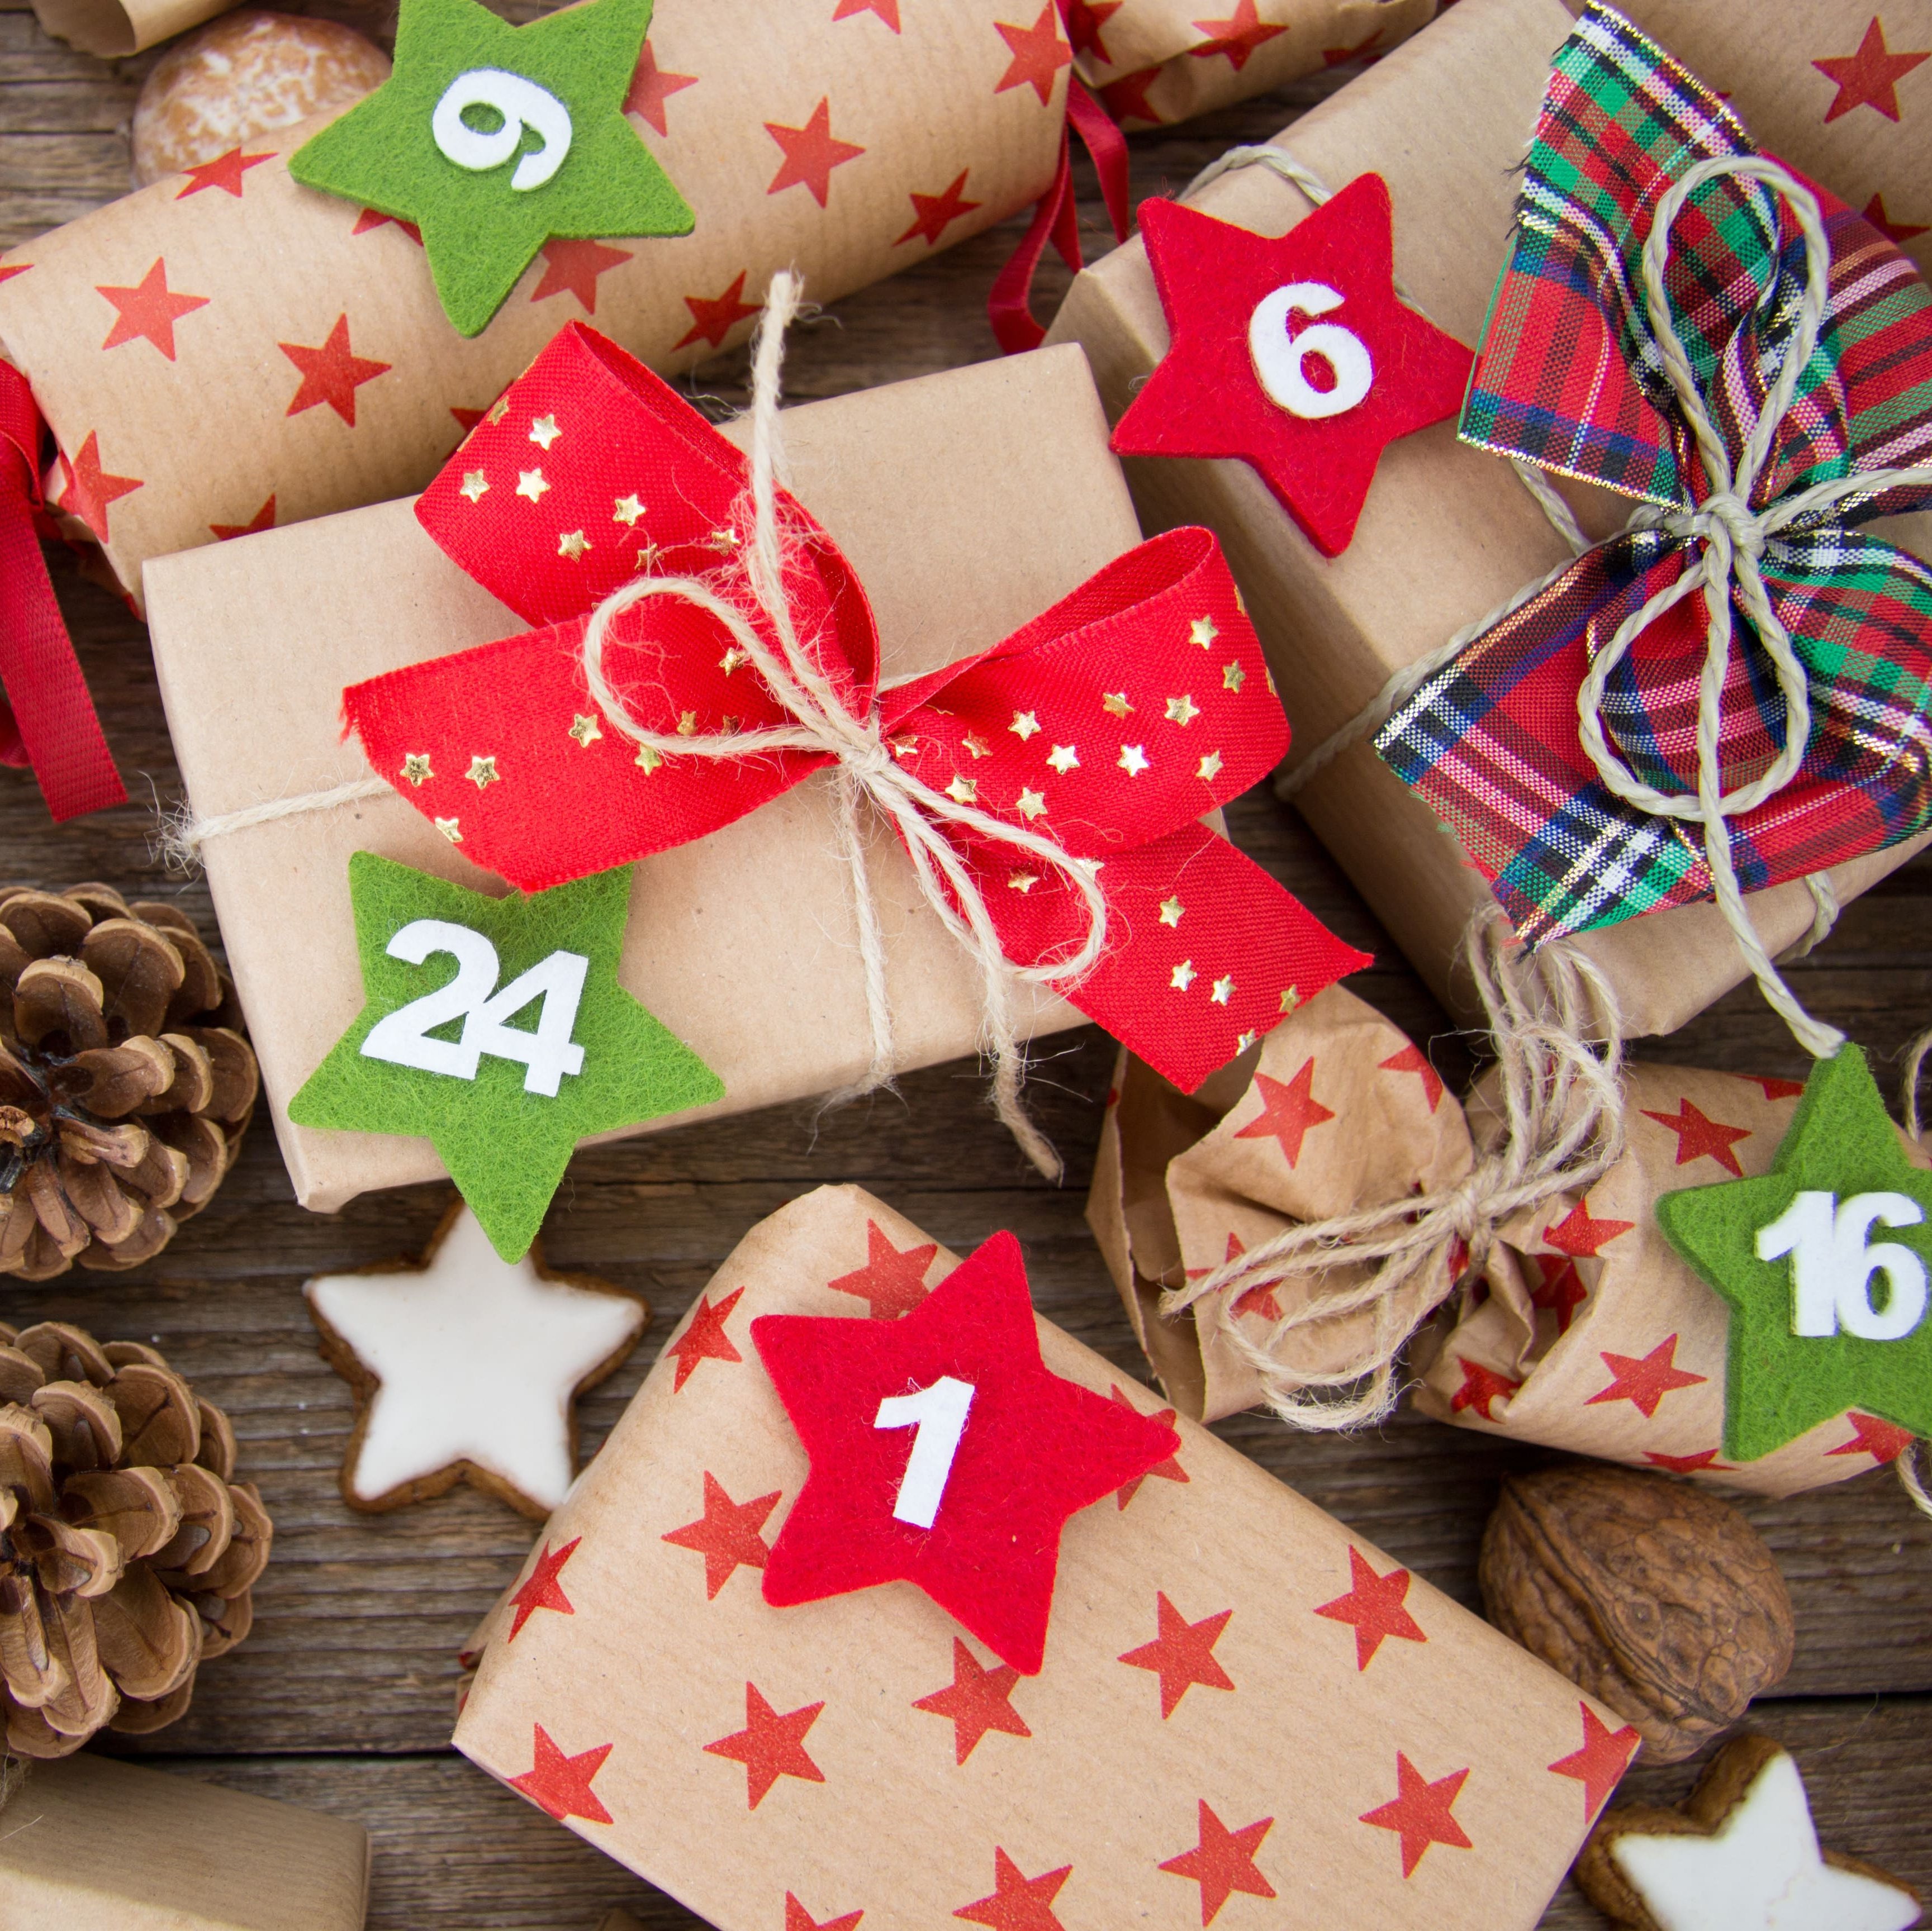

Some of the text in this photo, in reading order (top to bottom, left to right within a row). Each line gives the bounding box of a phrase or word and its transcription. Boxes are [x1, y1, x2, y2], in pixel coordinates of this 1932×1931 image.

[431, 65, 572, 193] 9
[1251, 283, 1371, 417] 6
[360, 919, 589, 1098] 24
[1755, 1191, 1929, 1341] 16
[874, 1377, 974, 1528] 1
